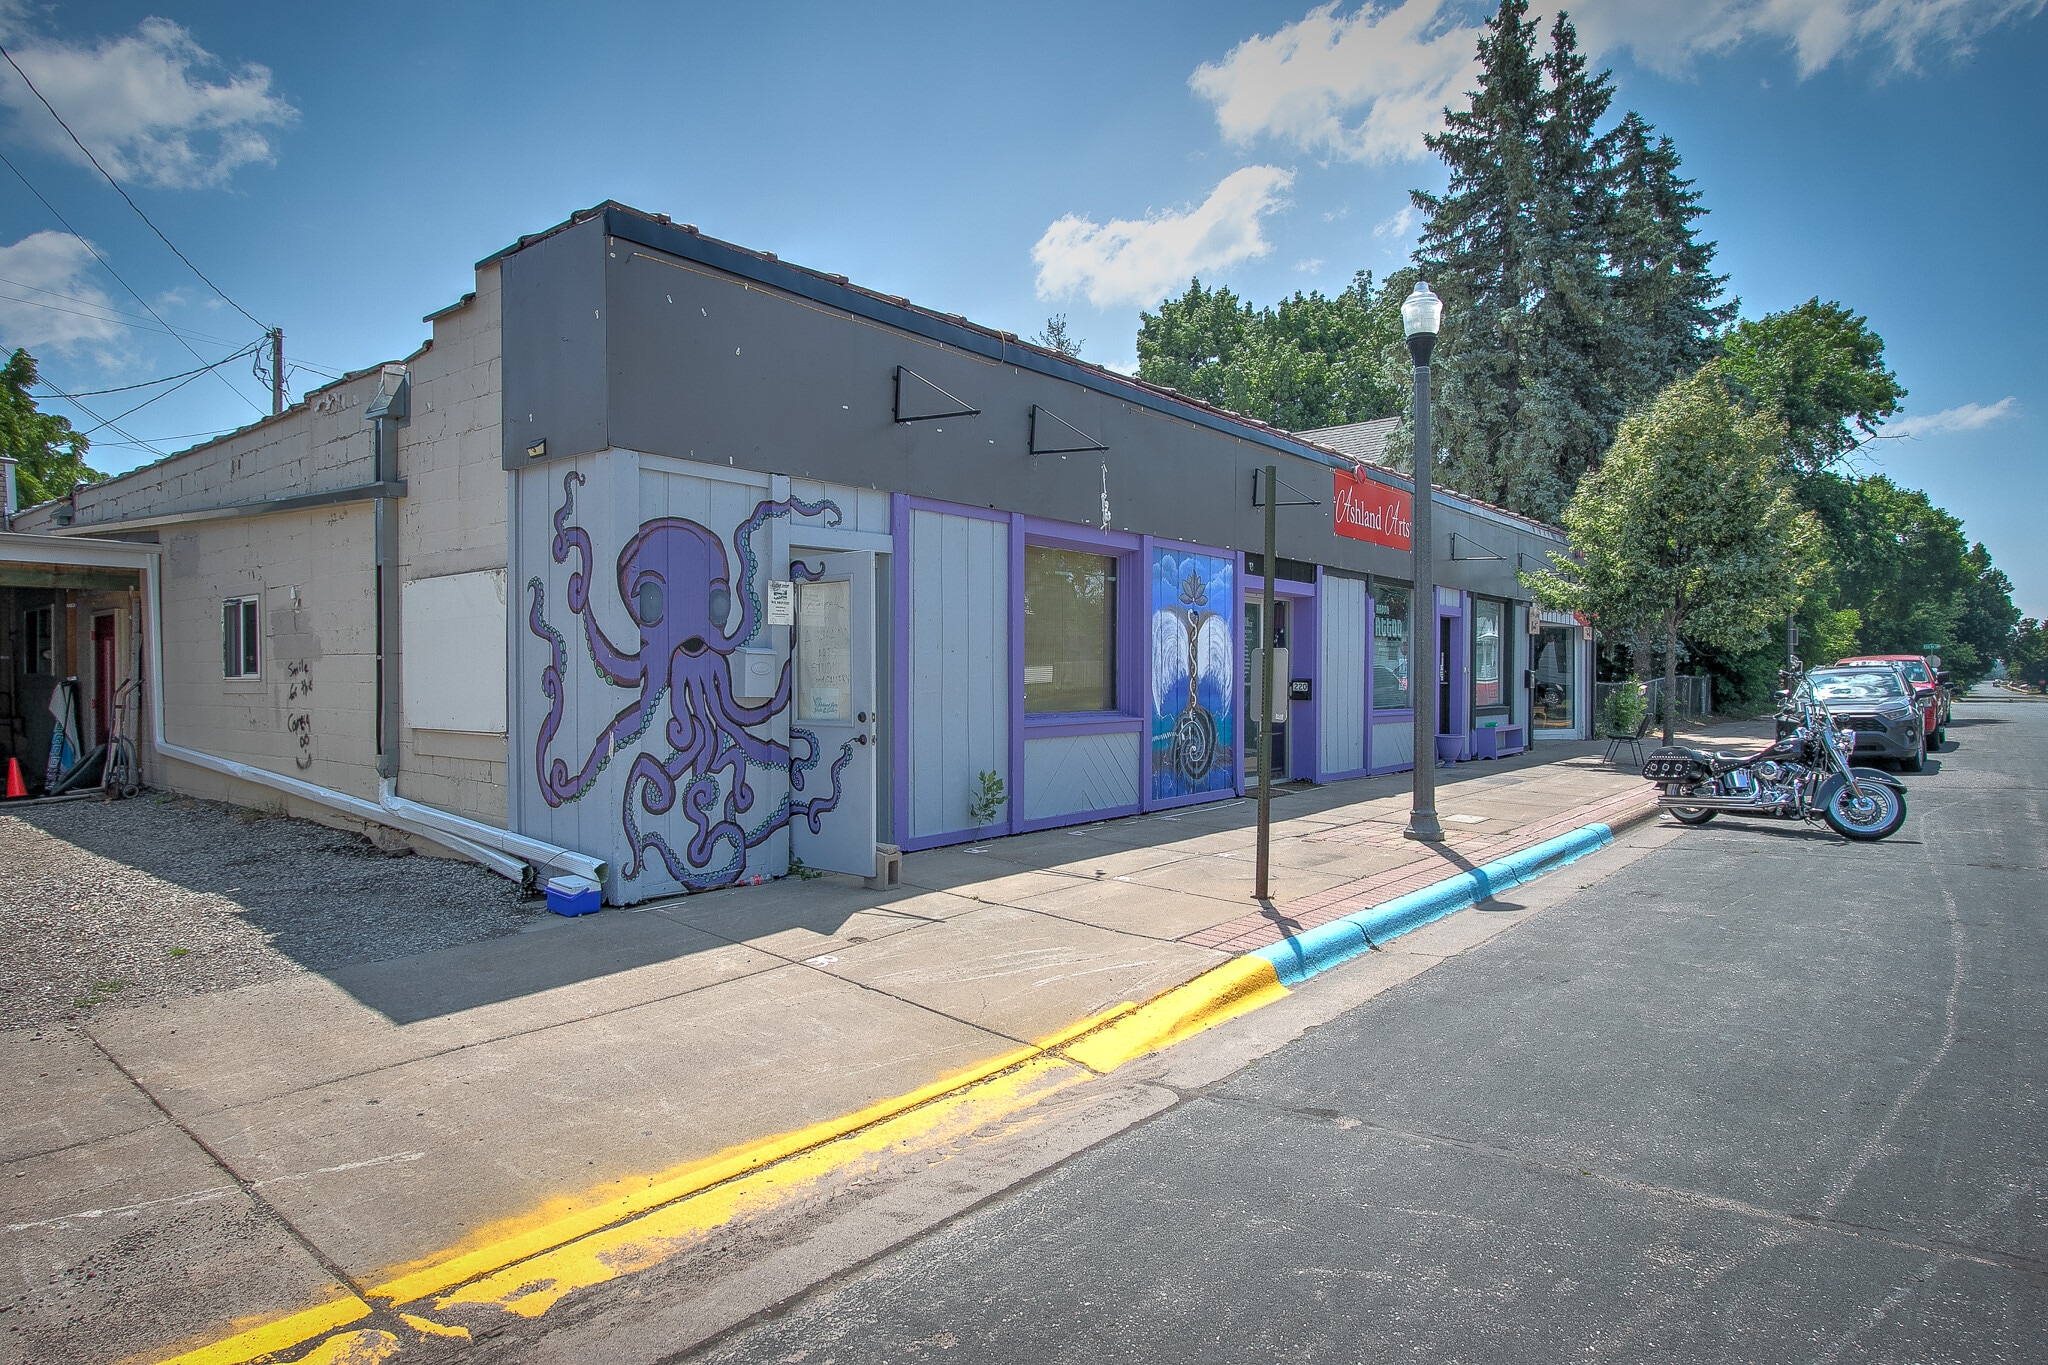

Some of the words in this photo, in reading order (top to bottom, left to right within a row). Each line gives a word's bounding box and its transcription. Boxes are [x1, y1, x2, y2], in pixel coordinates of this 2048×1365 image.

[1335, 486, 1382, 531] Ashland
[1384, 500, 1410, 538] Arts
[287, 658, 309, 678] Smile
[1293, 683, 1308, 691] 220
